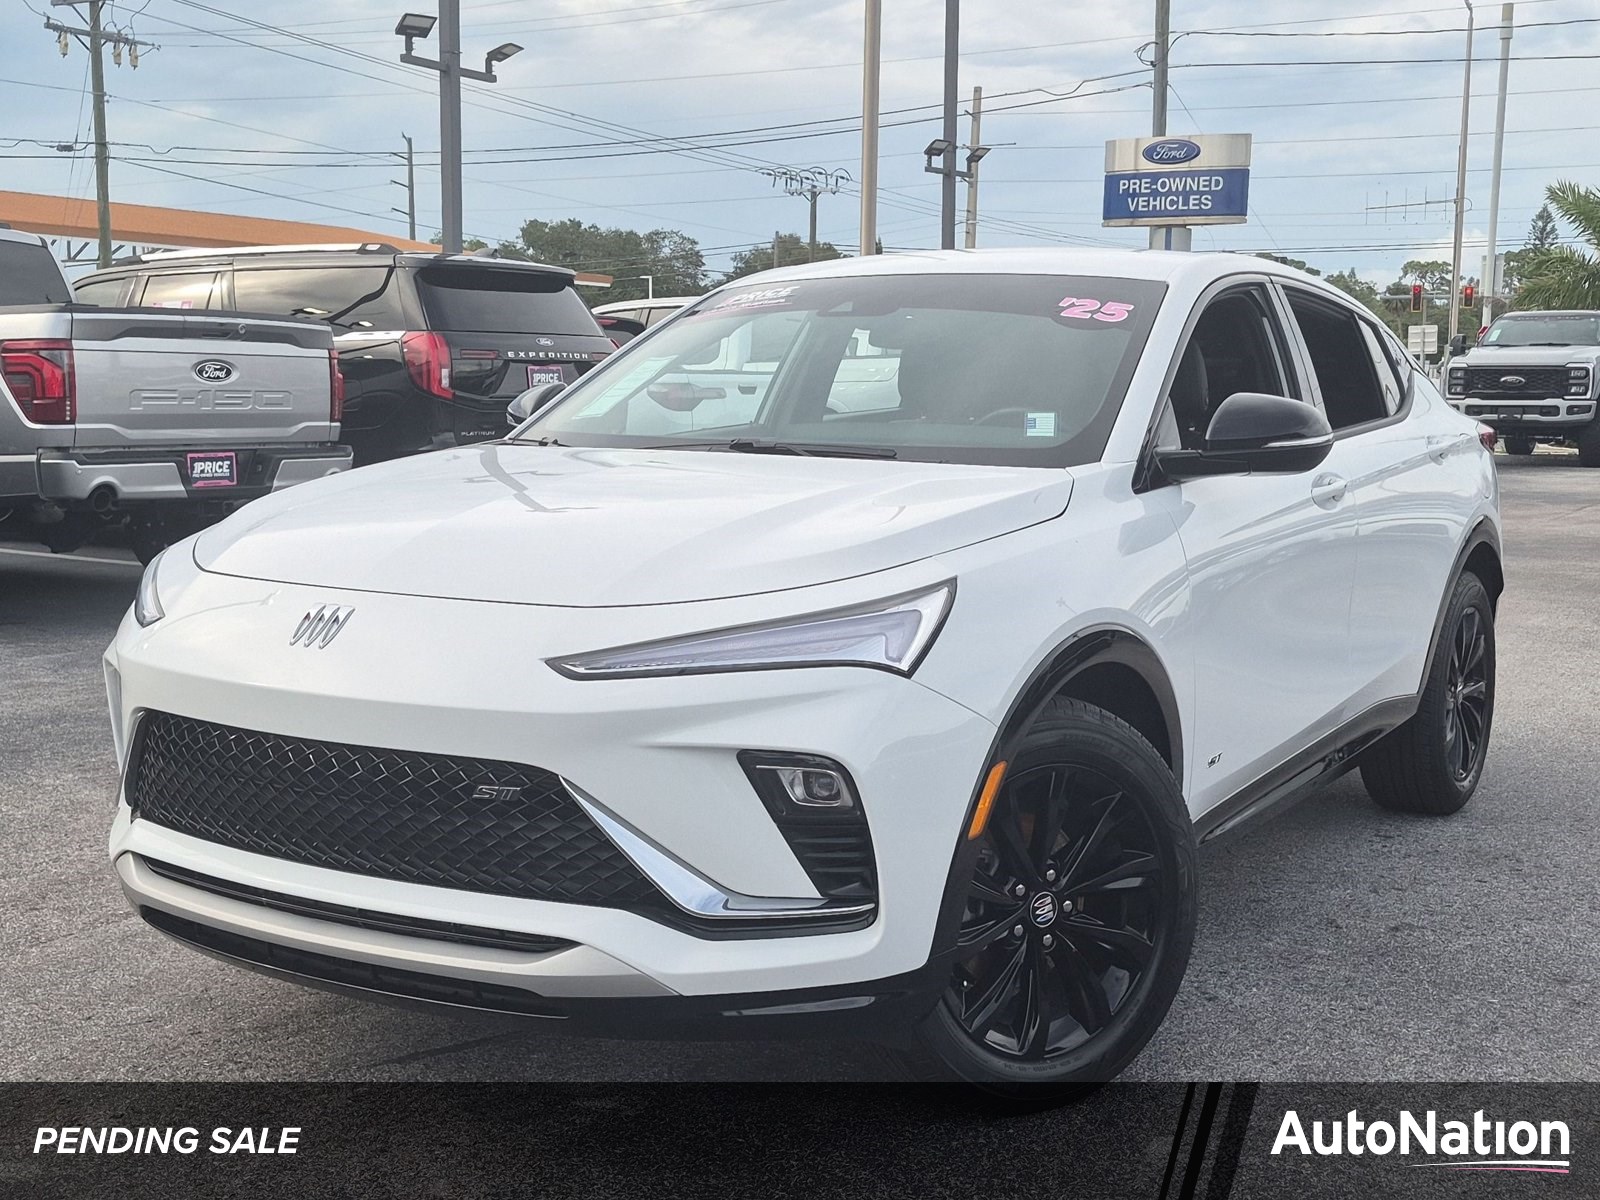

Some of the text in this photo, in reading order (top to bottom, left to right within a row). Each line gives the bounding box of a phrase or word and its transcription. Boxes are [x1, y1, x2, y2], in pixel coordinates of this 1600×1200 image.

[1152, 143, 1188, 160] Ford
[1119, 176, 1224, 194] PRE-OWNED
[1127, 195, 1212, 211] VEHICLES
[507, 351, 588, 359] EXPEDITION
[202, 364, 227, 379] Ford
[472, 785, 521, 800] ST
